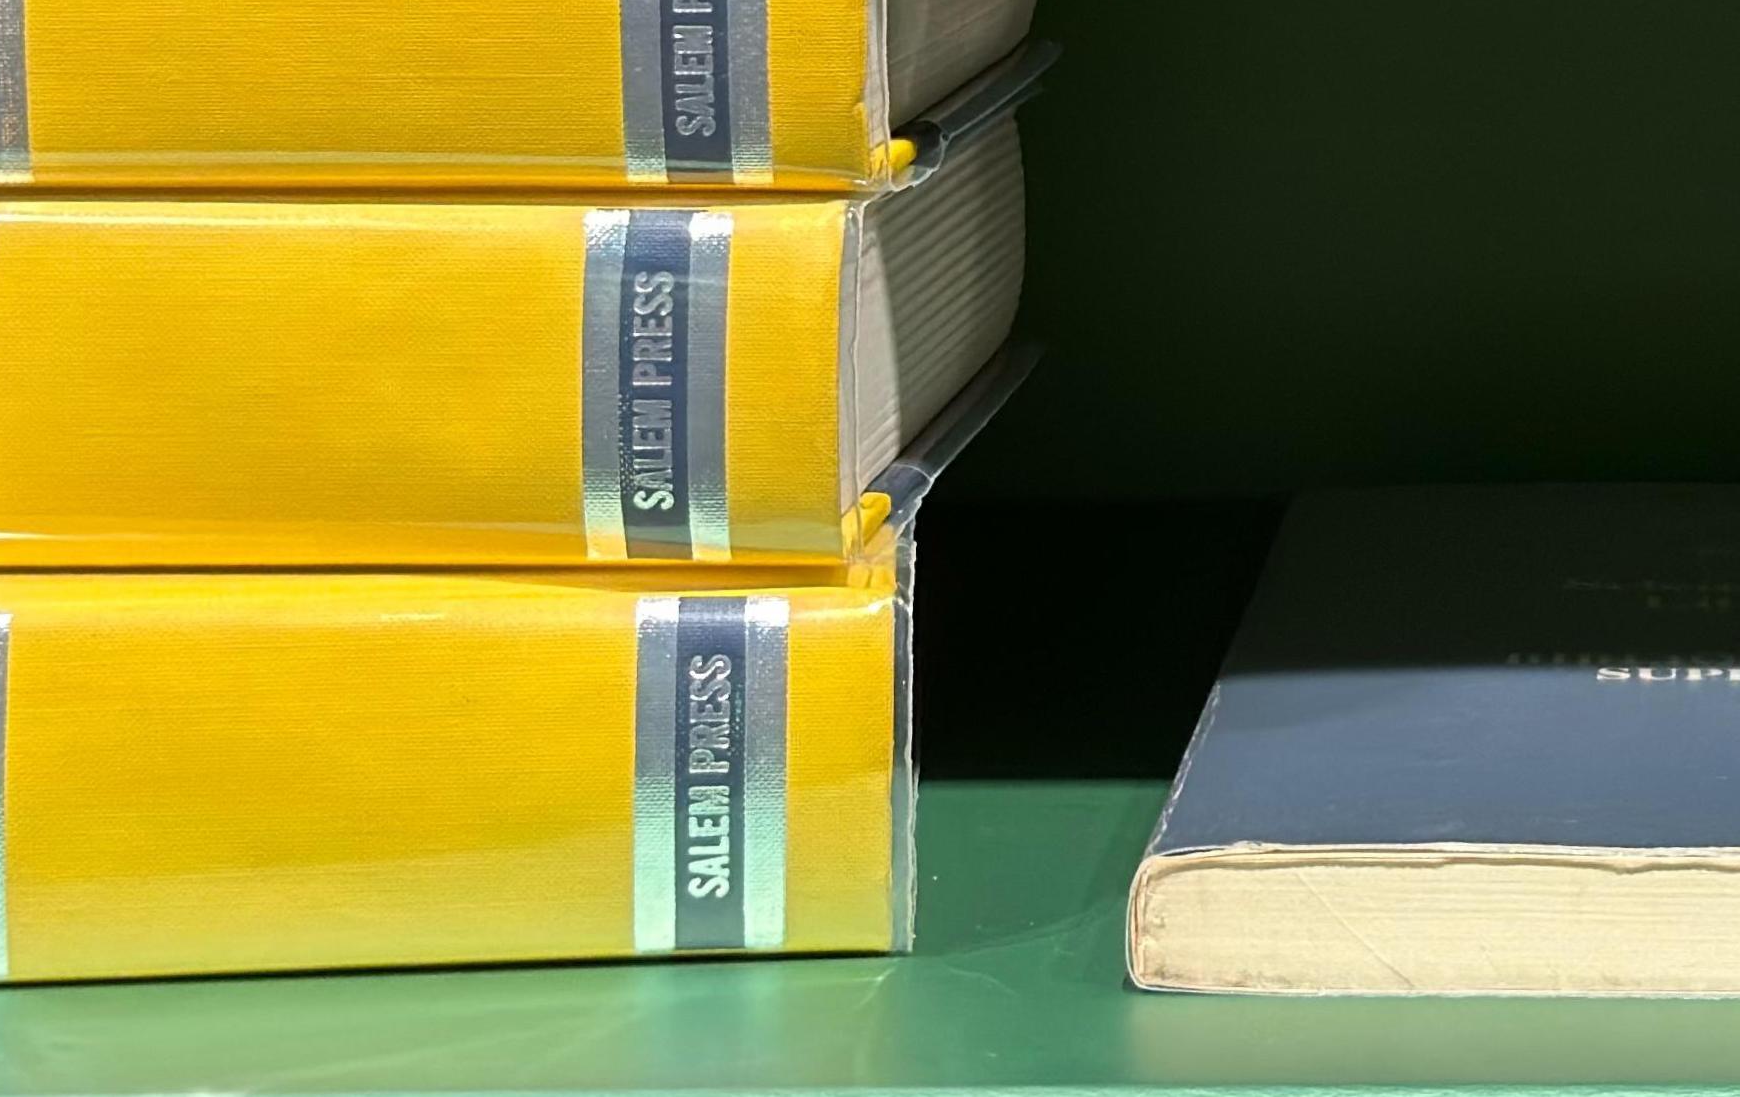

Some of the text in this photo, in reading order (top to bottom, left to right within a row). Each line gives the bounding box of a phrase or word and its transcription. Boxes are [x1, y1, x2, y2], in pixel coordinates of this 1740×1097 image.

[675, 25, 716, 137] SALEM
[633, 271, 674, 511] SALEM PRESS
[687, 653, 732, 901] SALEM PRESS
